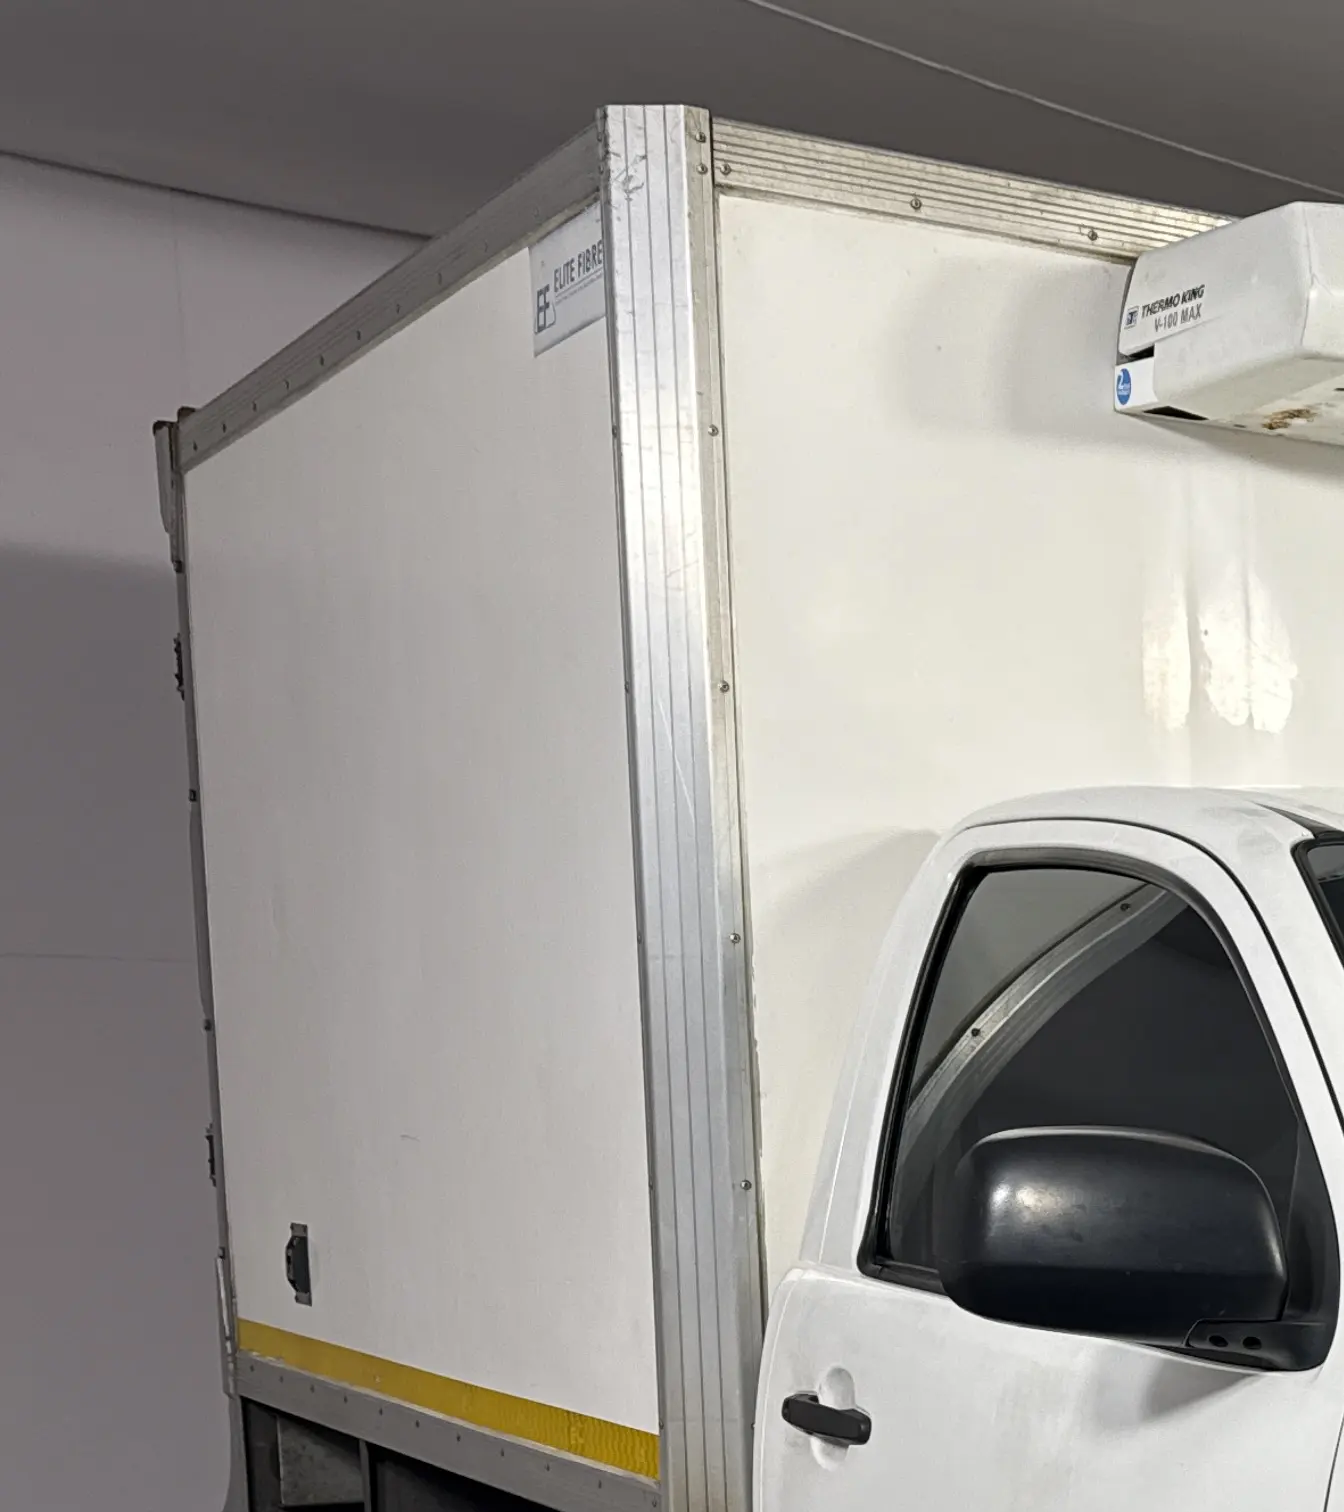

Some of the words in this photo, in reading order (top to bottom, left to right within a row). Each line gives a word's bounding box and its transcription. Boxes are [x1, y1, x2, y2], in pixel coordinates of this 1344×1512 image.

[554, 258, 575, 293] ELITE
[1141, 293, 1180, 319] THERMO
[1181, 284, 1205, 304] KING
[1181, 303, 1202, 324] MAX
